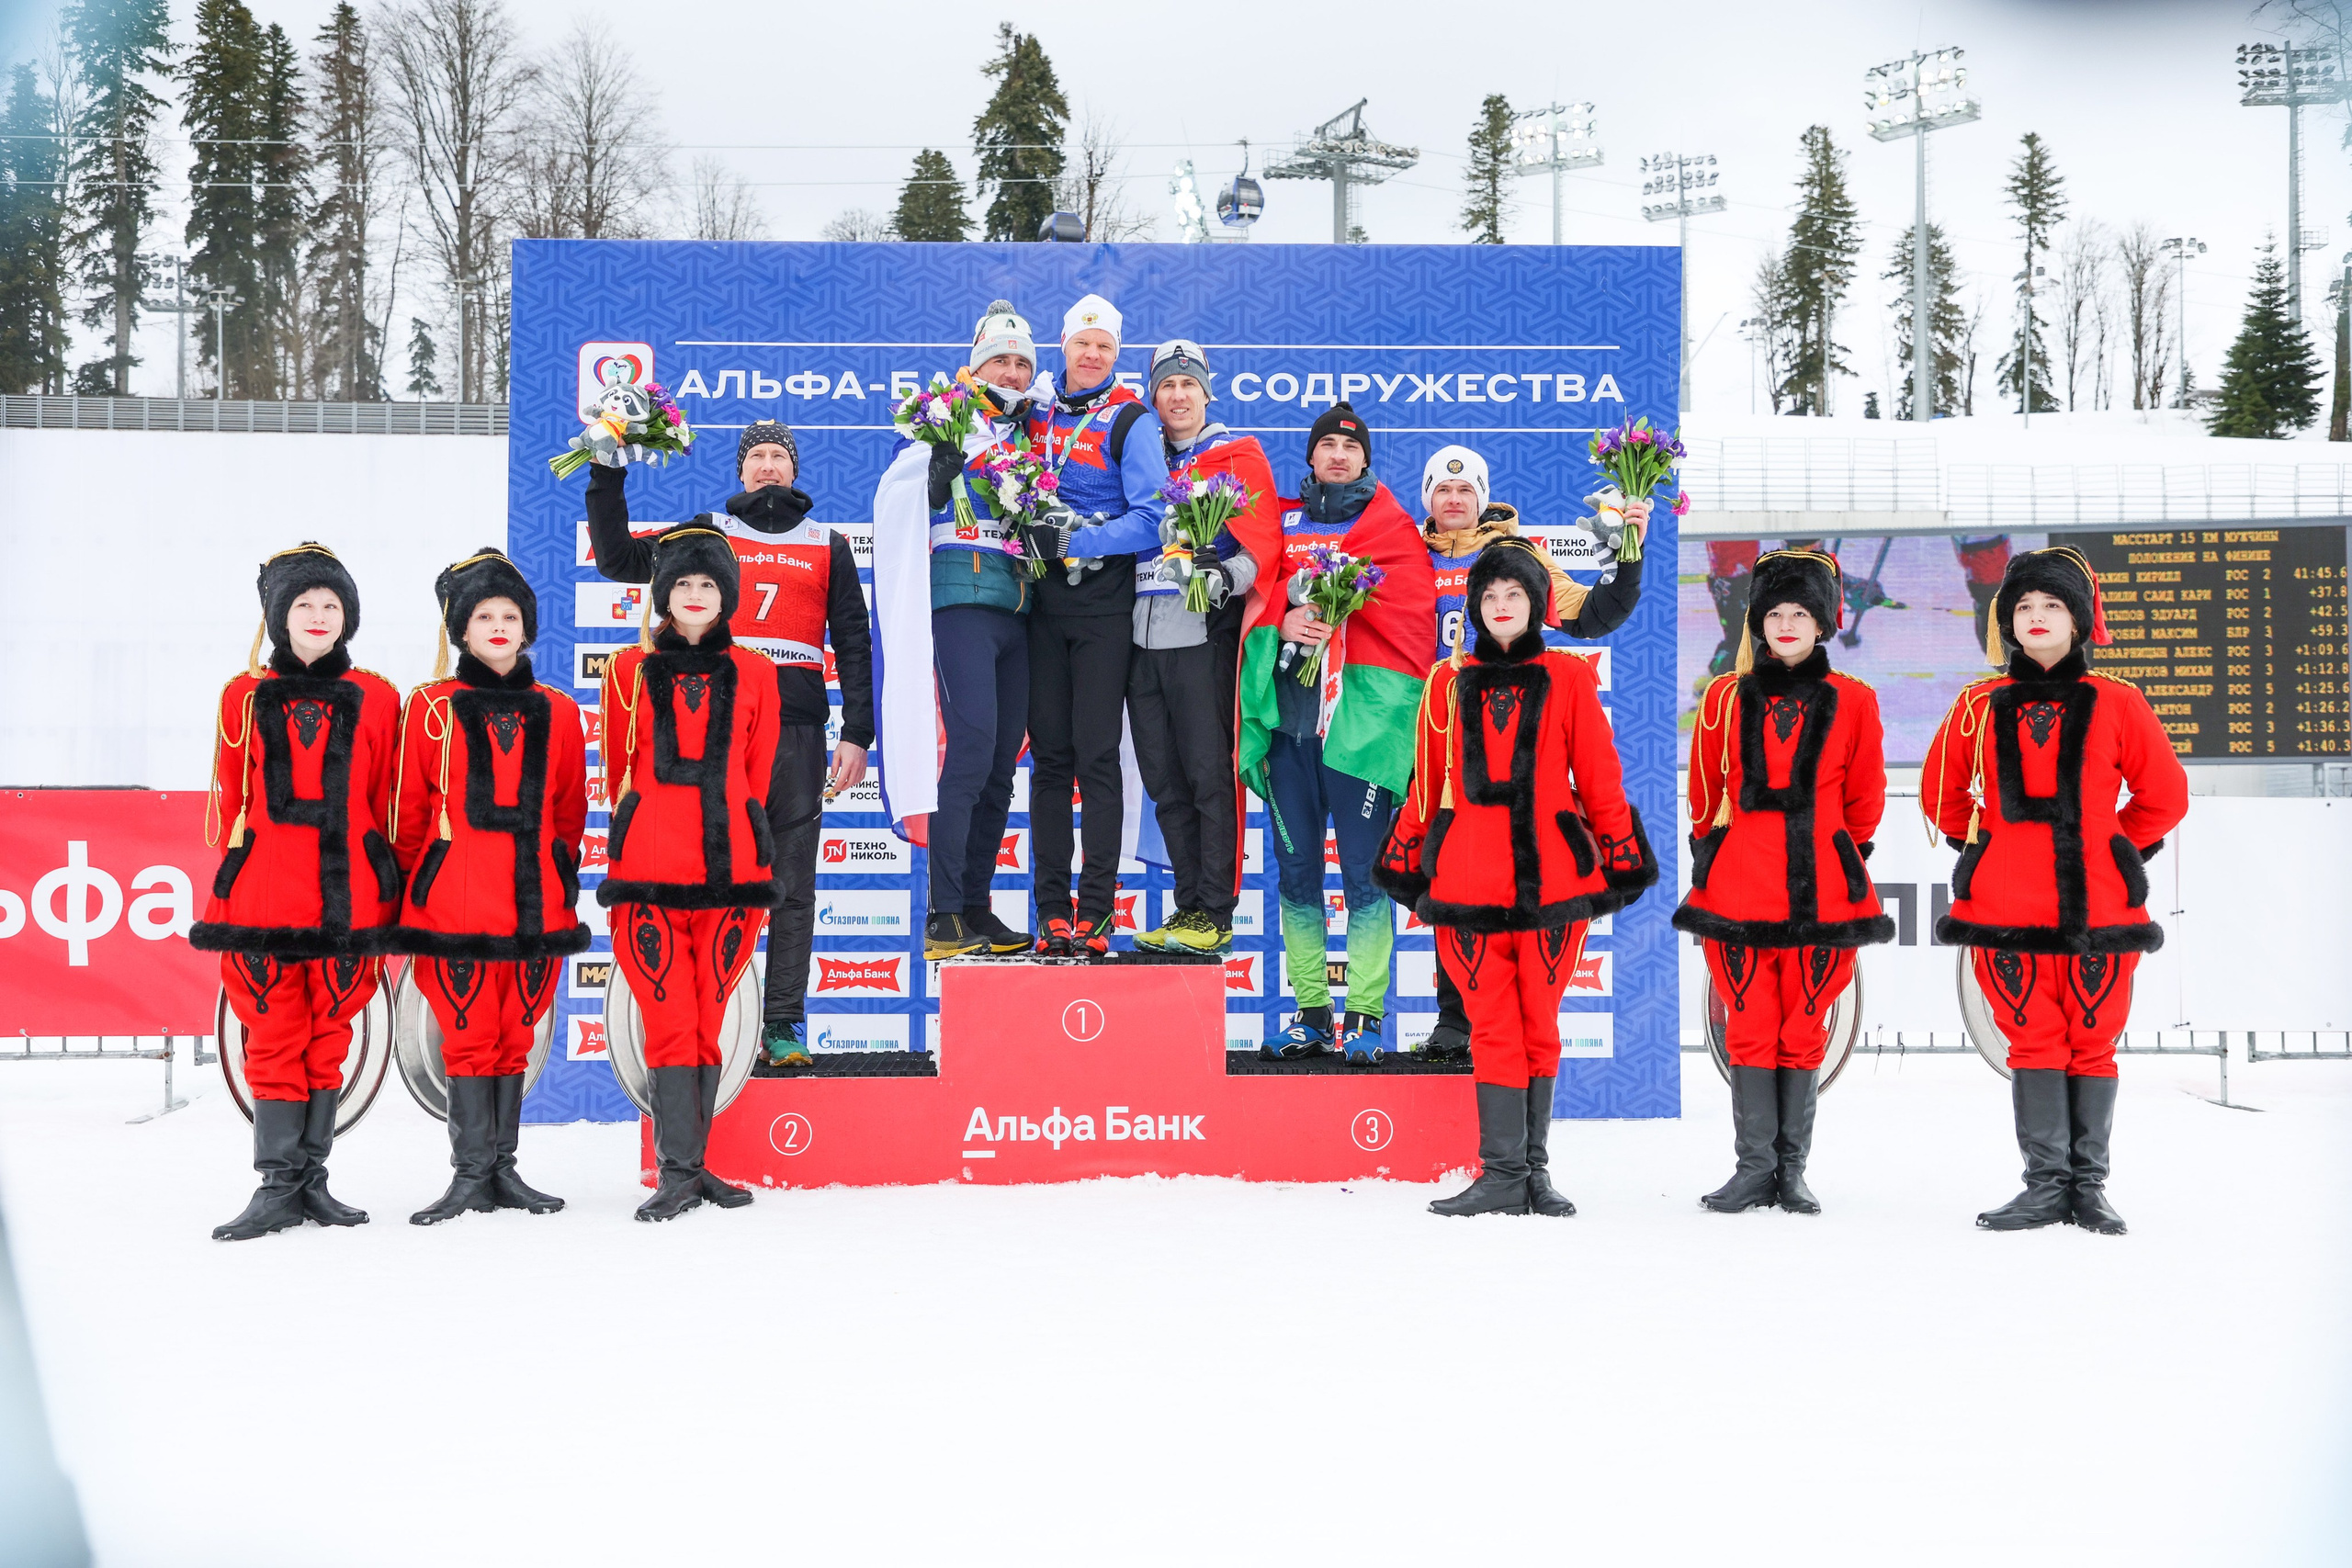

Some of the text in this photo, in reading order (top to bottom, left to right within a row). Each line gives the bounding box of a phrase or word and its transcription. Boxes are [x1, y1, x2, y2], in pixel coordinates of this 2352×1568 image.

[1230, 372, 1625, 408] СОДРУЖЕСТВА
[1549, 538, 1587, 547] ТЕХНО
[2113, 530, 2279, 546] МАССТАРТ 15 КМ МУЖЧИНЫ
[738, 552, 813, 571] льфа Банк
[2202, 551, 2220, 562] НА
[2225, 569, 2249, 581] РОС
[2263, 568, 2272, 580] 2
[2293, 566, 2347, 580] 41:45.6
[2101, 591, 2138, 603] АЛИЛИ
[2226, 588, 2249, 600] РОС
[2264, 587, 2271, 600] 1
[2309, 585, 2347, 598] +37.8
[755, 581, 780, 622] 7
[2103, 604, 2348, 622] АТЫПОВ ЭДУАРД РОС 2 +42.5
[2151, 627, 2198, 639] МАКСИМ
[2264, 626, 2273, 638] 3
[2310, 624, 2348, 637] +59.3
[2227, 645, 2251, 658] РОС
[2265, 644, 2273, 657] 3
[2295, 643, 2349, 656] +1:09.6
[2227, 664, 2251, 676] РОС
[2265, 663, 2274, 676] 3
[2295, 662, 2349, 675] +1:12.8
[2227, 683, 2252, 695] РОС
[2265, 682, 2274, 694] 5
[2296, 682, 2350, 694] +1:25.6
[2228, 703, 2252, 715] РОС
[2266, 702, 2275, 715] 2
[2296, 701, 2350, 714] +1:26.2
[2163, 720, 2351, 734] ОСЛАВ РОС 3 +1:36.3
[2229, 739, 2351, 753] РОС 5 +1:40.3
[849, 841, 888, 851] ТЕХНО
[851, 852, 898, 861] НИКОЛЬ
[833, 916, 900, 925] ГАЗПРОМ ПОЛЯНА
[827, 968, 891, 980] Альфа Банк
[1226, 969, 1245, 977] анк
[831, 1039, 899, 1049] ГАЗПРОМ ПОЛЯНА
[1575, 1038, 1604, 1048] ПОЛЯНА
[963, 1105, 1206, 1151] Альфа Банк
